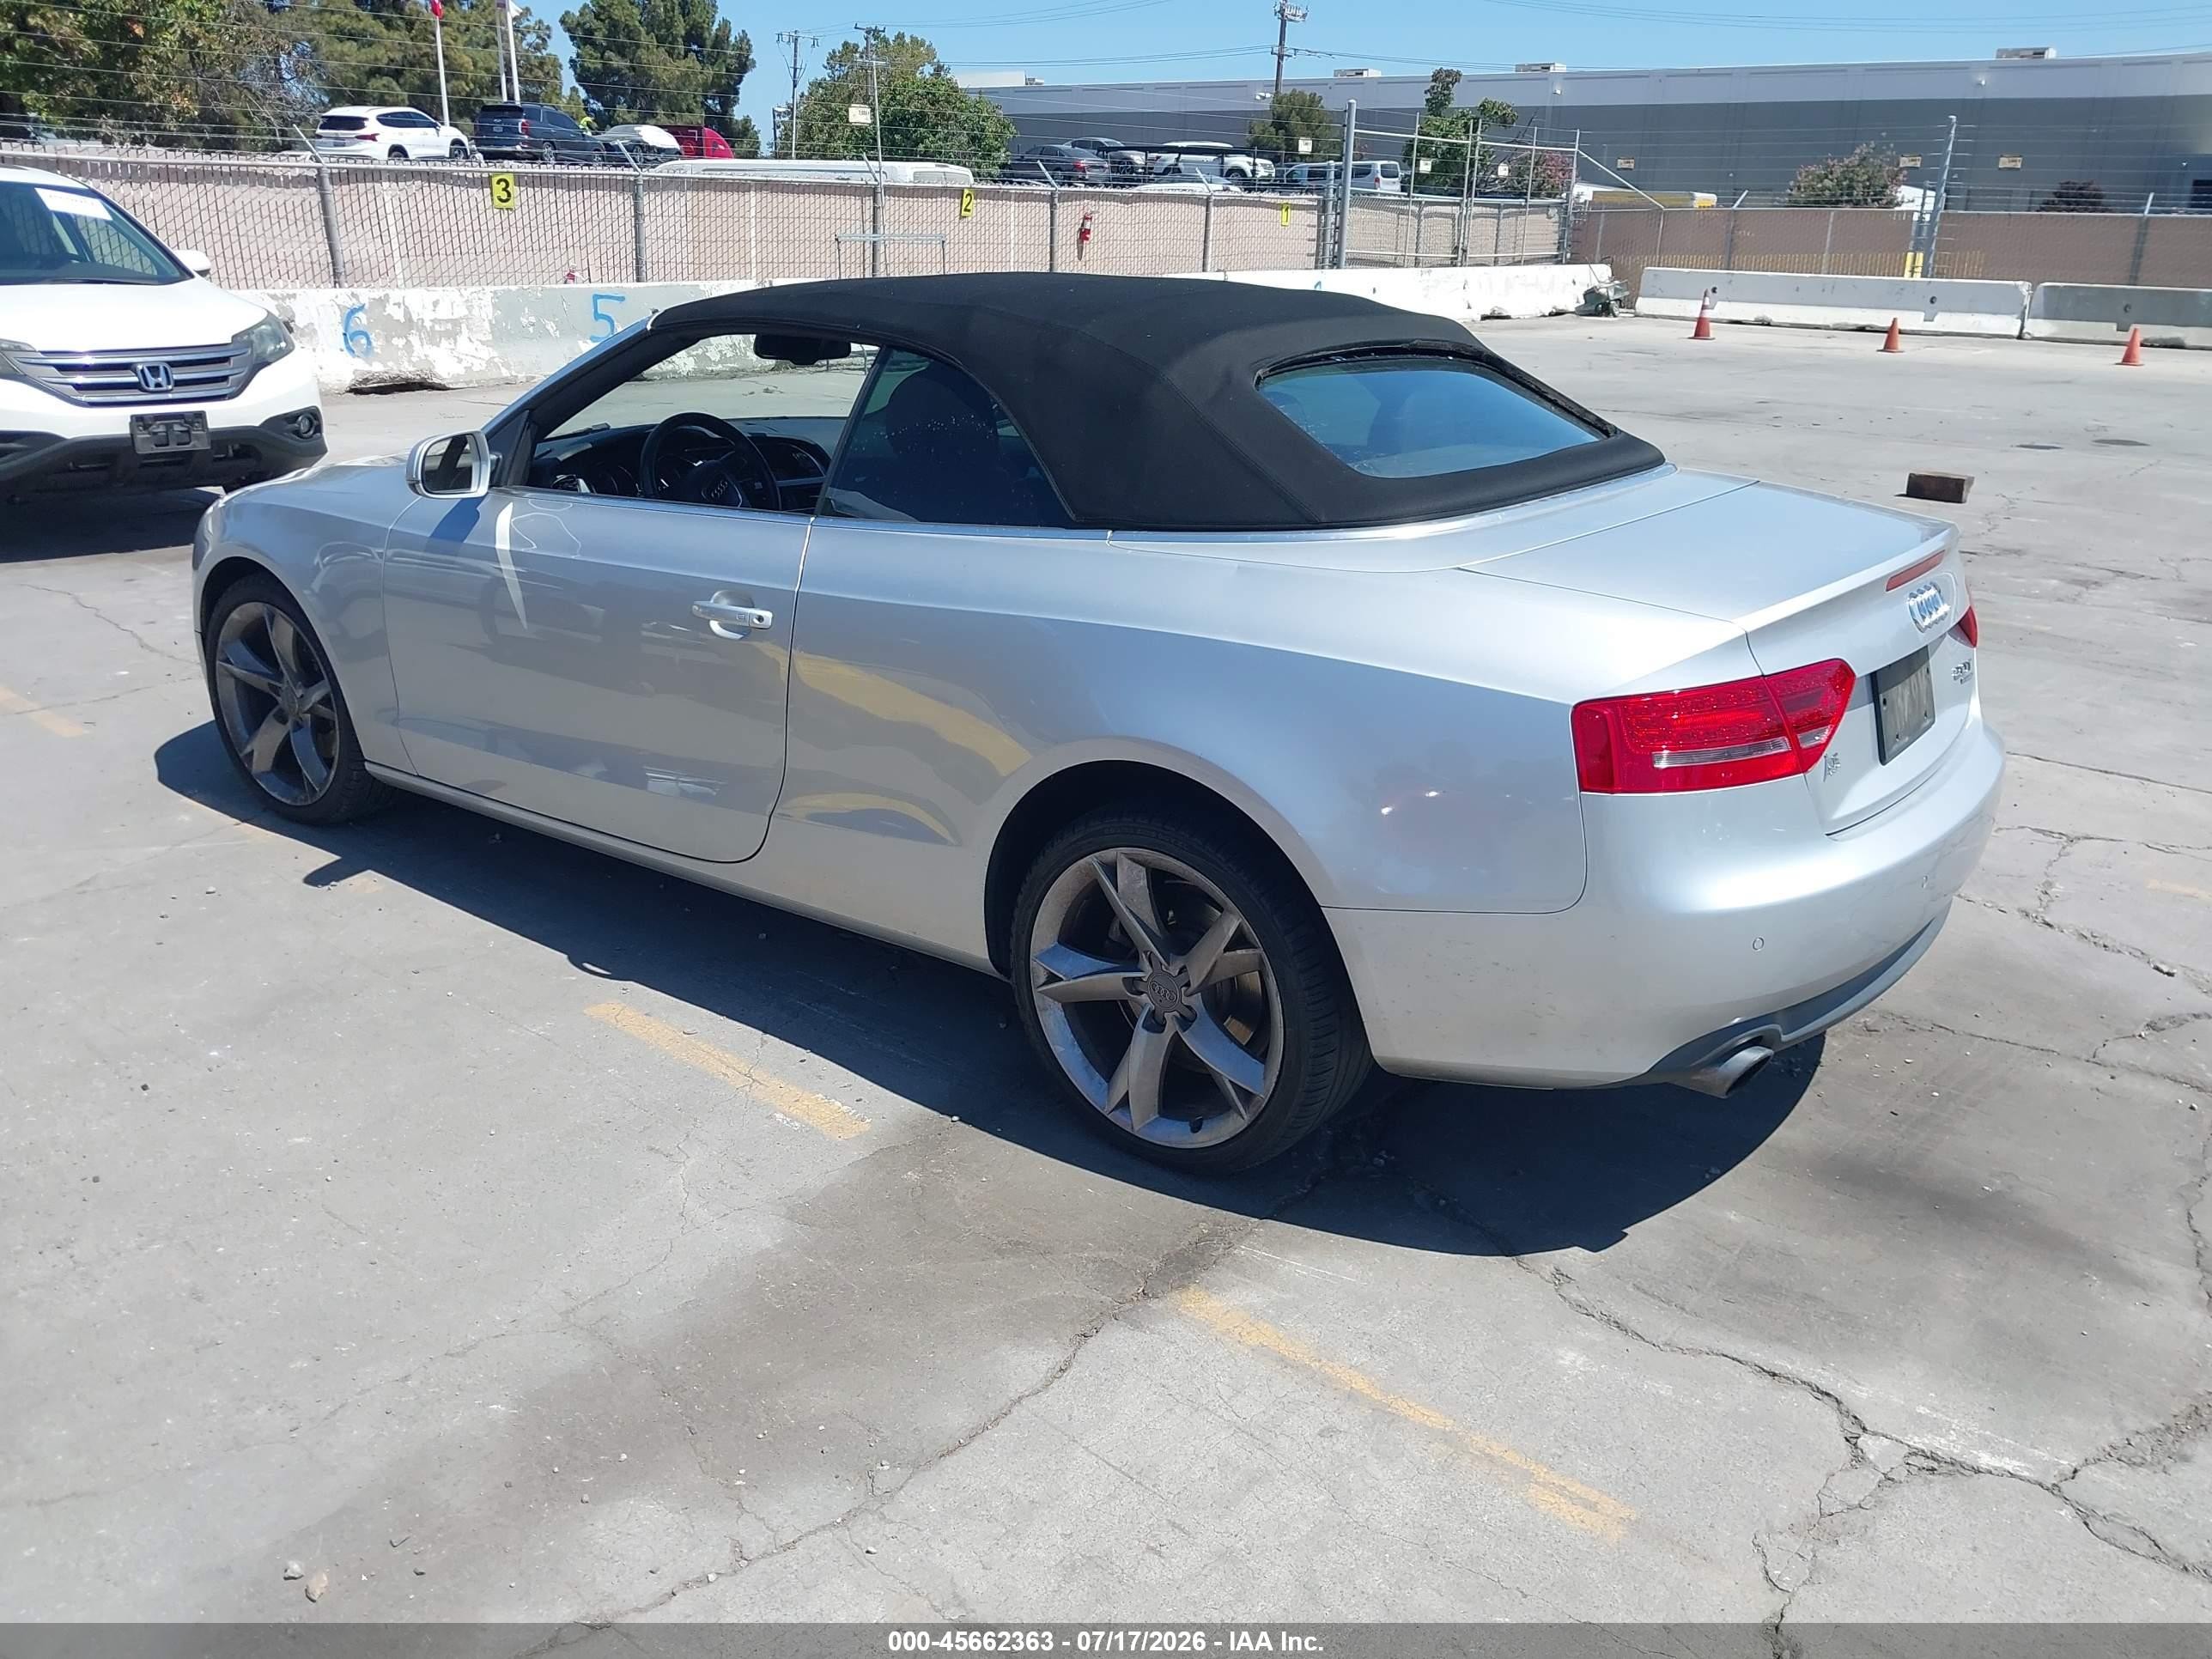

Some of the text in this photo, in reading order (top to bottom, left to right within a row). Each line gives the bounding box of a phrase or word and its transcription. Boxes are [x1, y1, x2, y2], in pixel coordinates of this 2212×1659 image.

[496, 178, 512, 204] 3
[963, 192, 973, 212] 2
[343, 303, 373, 359] 6
[590, 294, 626, 343] 5
